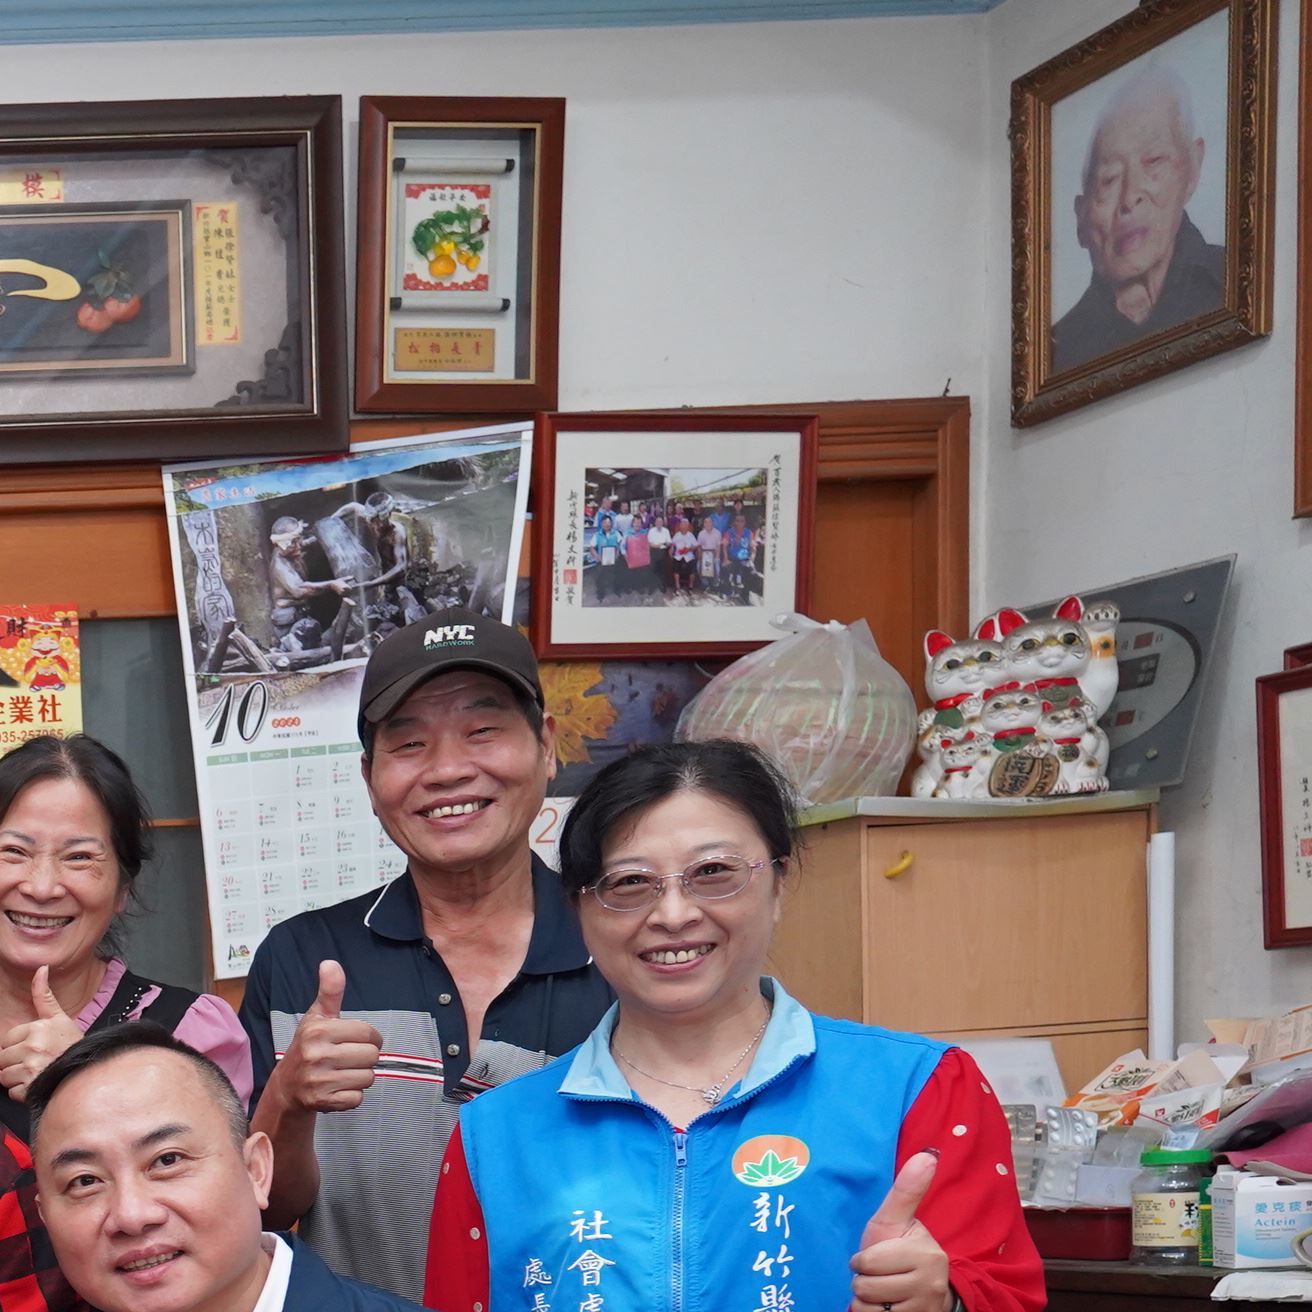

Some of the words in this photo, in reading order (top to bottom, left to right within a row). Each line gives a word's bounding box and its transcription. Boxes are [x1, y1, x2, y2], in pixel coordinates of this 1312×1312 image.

[424, 625, 475, 646] NYC
[425, 640, 475, 651] HARDWORK
[205, 680, 269, 748] 10
[1255, 1218, 1296, 1227] Actein
